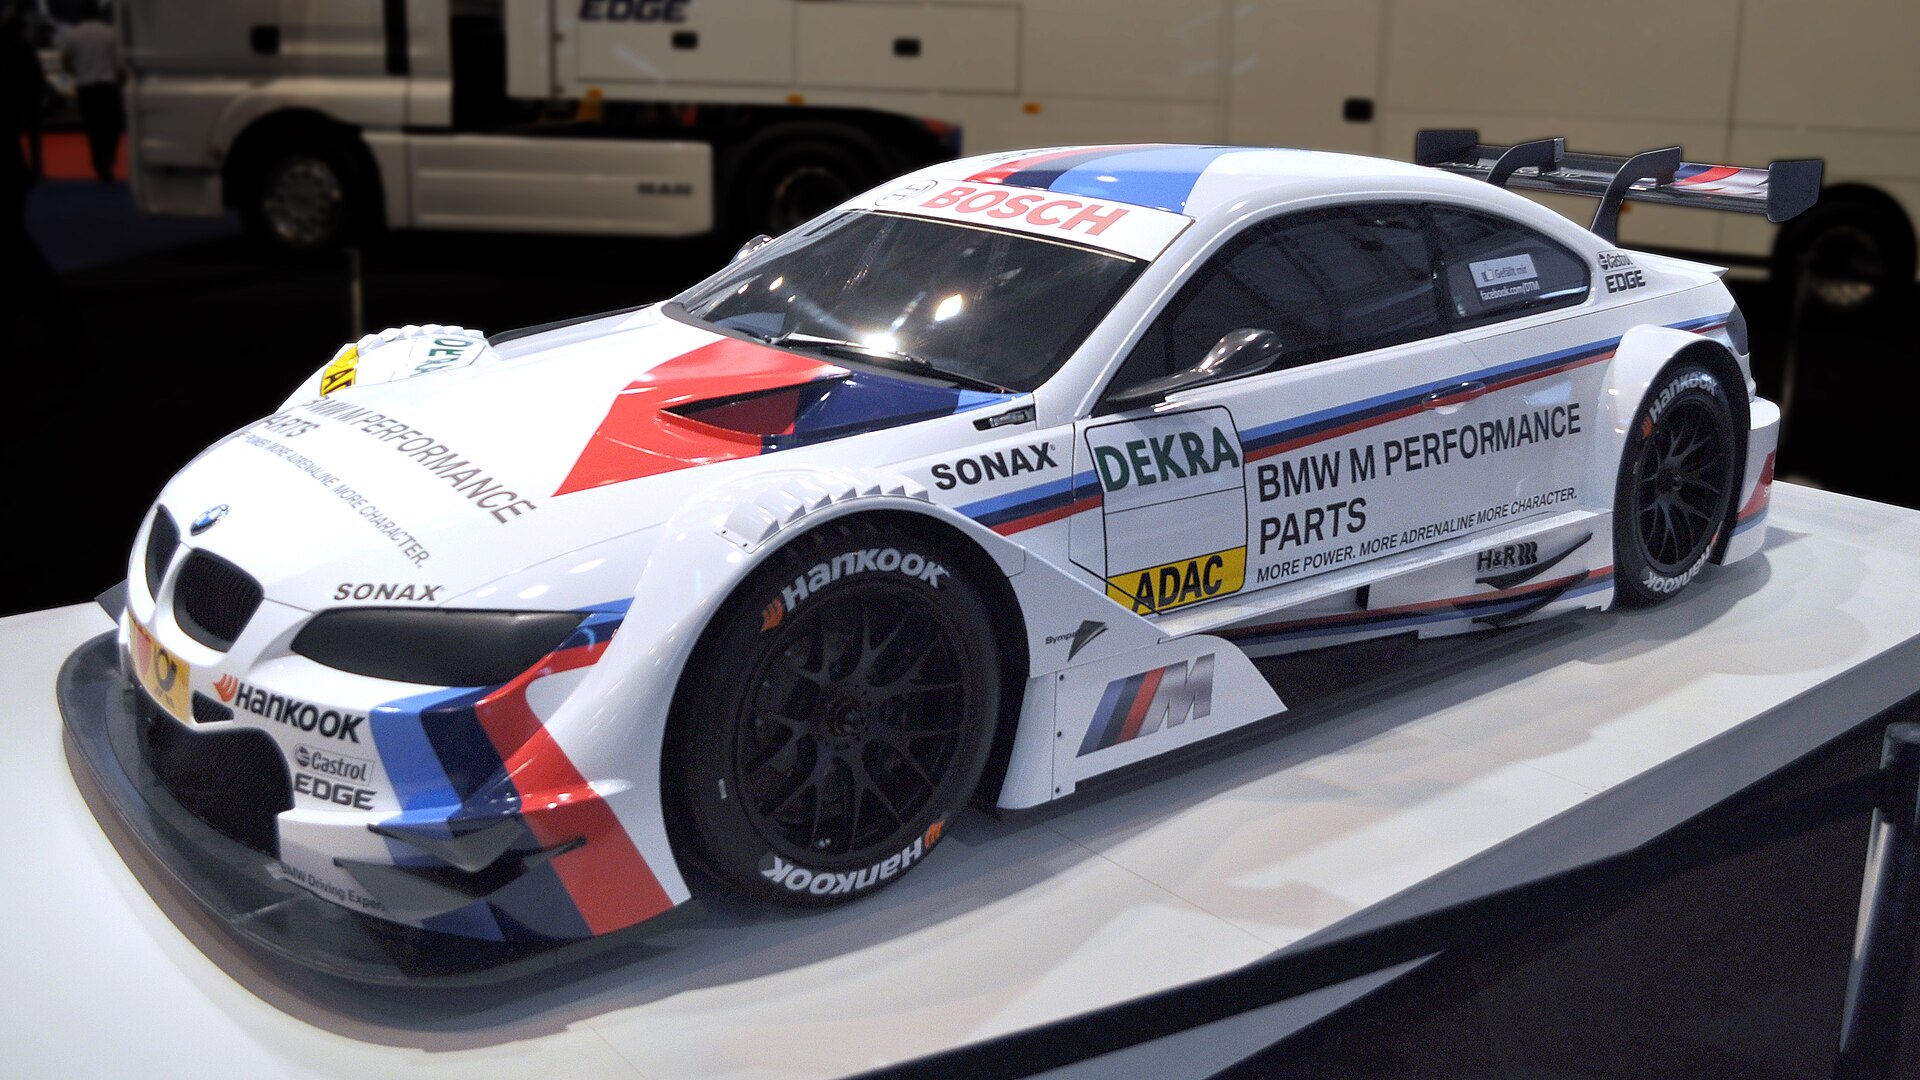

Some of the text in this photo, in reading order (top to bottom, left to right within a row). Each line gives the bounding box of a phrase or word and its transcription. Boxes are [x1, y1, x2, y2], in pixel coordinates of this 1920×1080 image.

[578, 0, 691, 22] EDGE
[919, 186, 1131, 236] BOSCH
[1605, 270, 1646, 293] EDGE
[349, 414, 537, 524] PERFORMANCE
[1094, 426, 1240, 492] DEKRA
[1257, 402, 1581, 503] BMW M PERFORMANCE
[332, 484, 368, 509] MORE
[359, 505, 430, 568] CHARACTER.
[1256, 558, 1300, 583] MORE
[1302, 549, 1356, 574] POWER.
[1359, 535, 1397, 556] MORE
[1476, 504, 1509, 524] MORE
[1511, 487, 1577, 515] CHARACTER.
[1259, 497, 1367, 555] PARTS
[1132, 555, 1224, 614] ADAC
[294, 773, 377, 810] EDGE
[311, 751, 368, 782] Castrol
